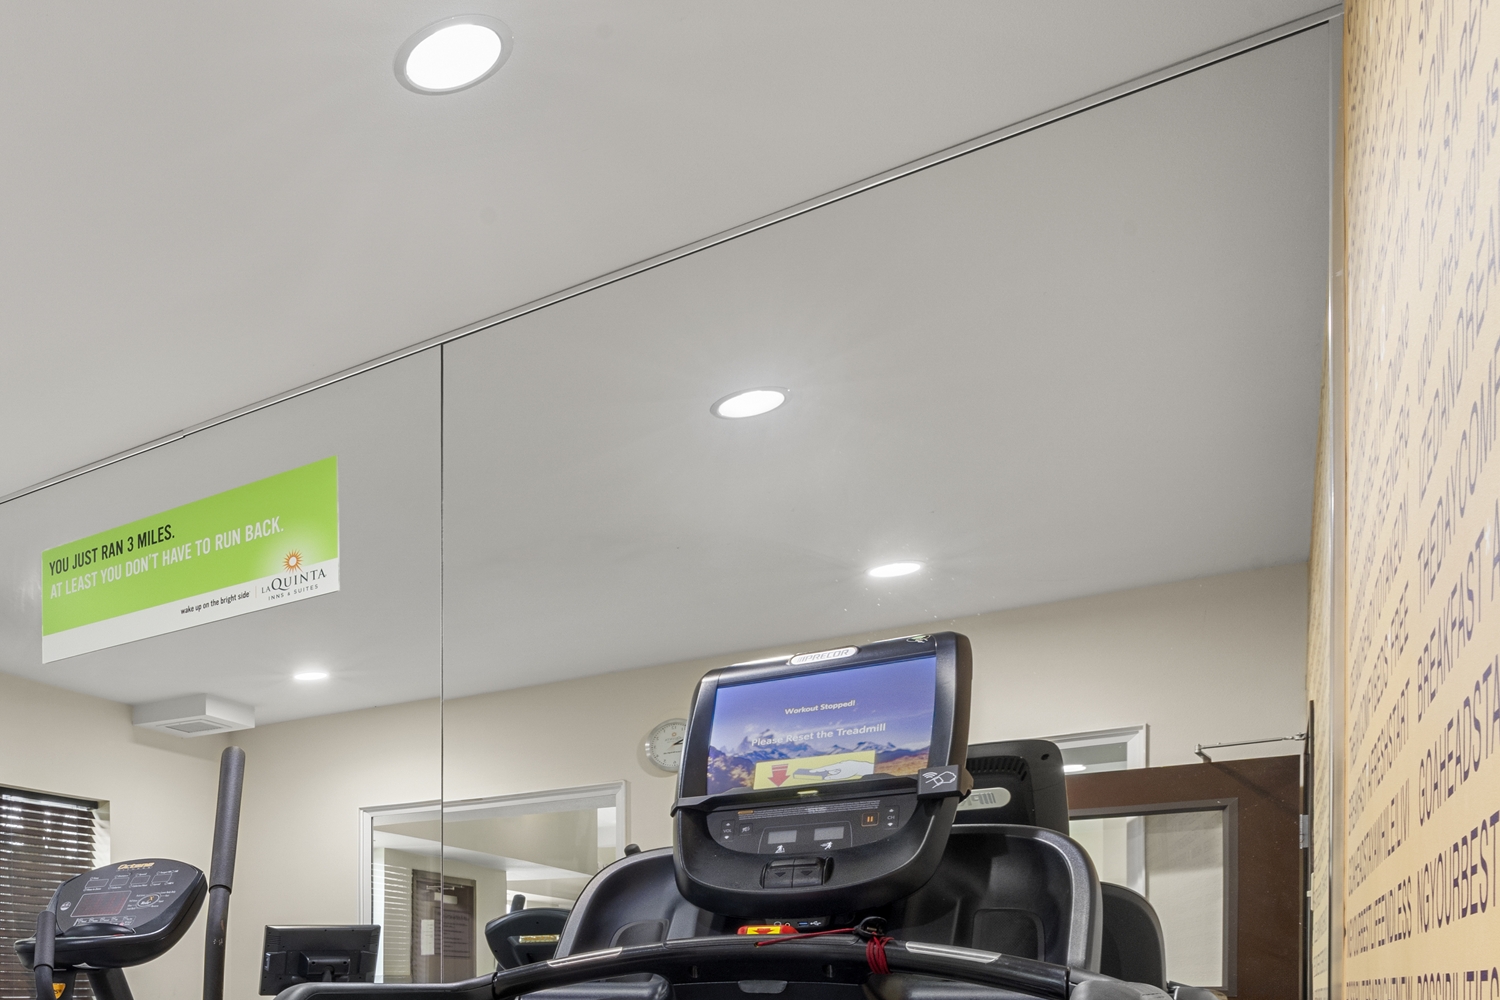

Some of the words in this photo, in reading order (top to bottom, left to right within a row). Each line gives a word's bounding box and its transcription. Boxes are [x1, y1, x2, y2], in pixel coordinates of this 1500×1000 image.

[49, 557, 69, 576] YOU
[72, 547, 98, 570] JUST
[102, 540, 123, 560] RAN
[127, 536, 134, 552] 3
[137, 524, 175, 549] MILES.
[50, 582, 63, 600] AT
[66, 571, 98, 595] LEAST
[101, 564, 122, 584] YOU
[126, 552, 159, 577] DON'T
[162, 543, 192, 566] HAVE
[195, 537, 211, 556] TO
[215, 528, 241, 551] RUN
[245, 516, 284, 542] BACK.
[268, 593, 284, 601] INNS
[294, 584, 319, 595] SUITES
[180, 604, 194, 614] wake
[195, 603, 202, 612] up
[210, 597, 220, 608] the
[220, 593, 237, 605] bright
[804, 649, 849, 662] PRECOR
[784, 705, 819, 715] Workout
[820, 700, 856, 711] Stopped!
[751, 737, 783, 746] Please
[786, 733, 814, 743] Reset
[816, 731, 833, 739] the
[836, 723, 886, 736] Treadmill
